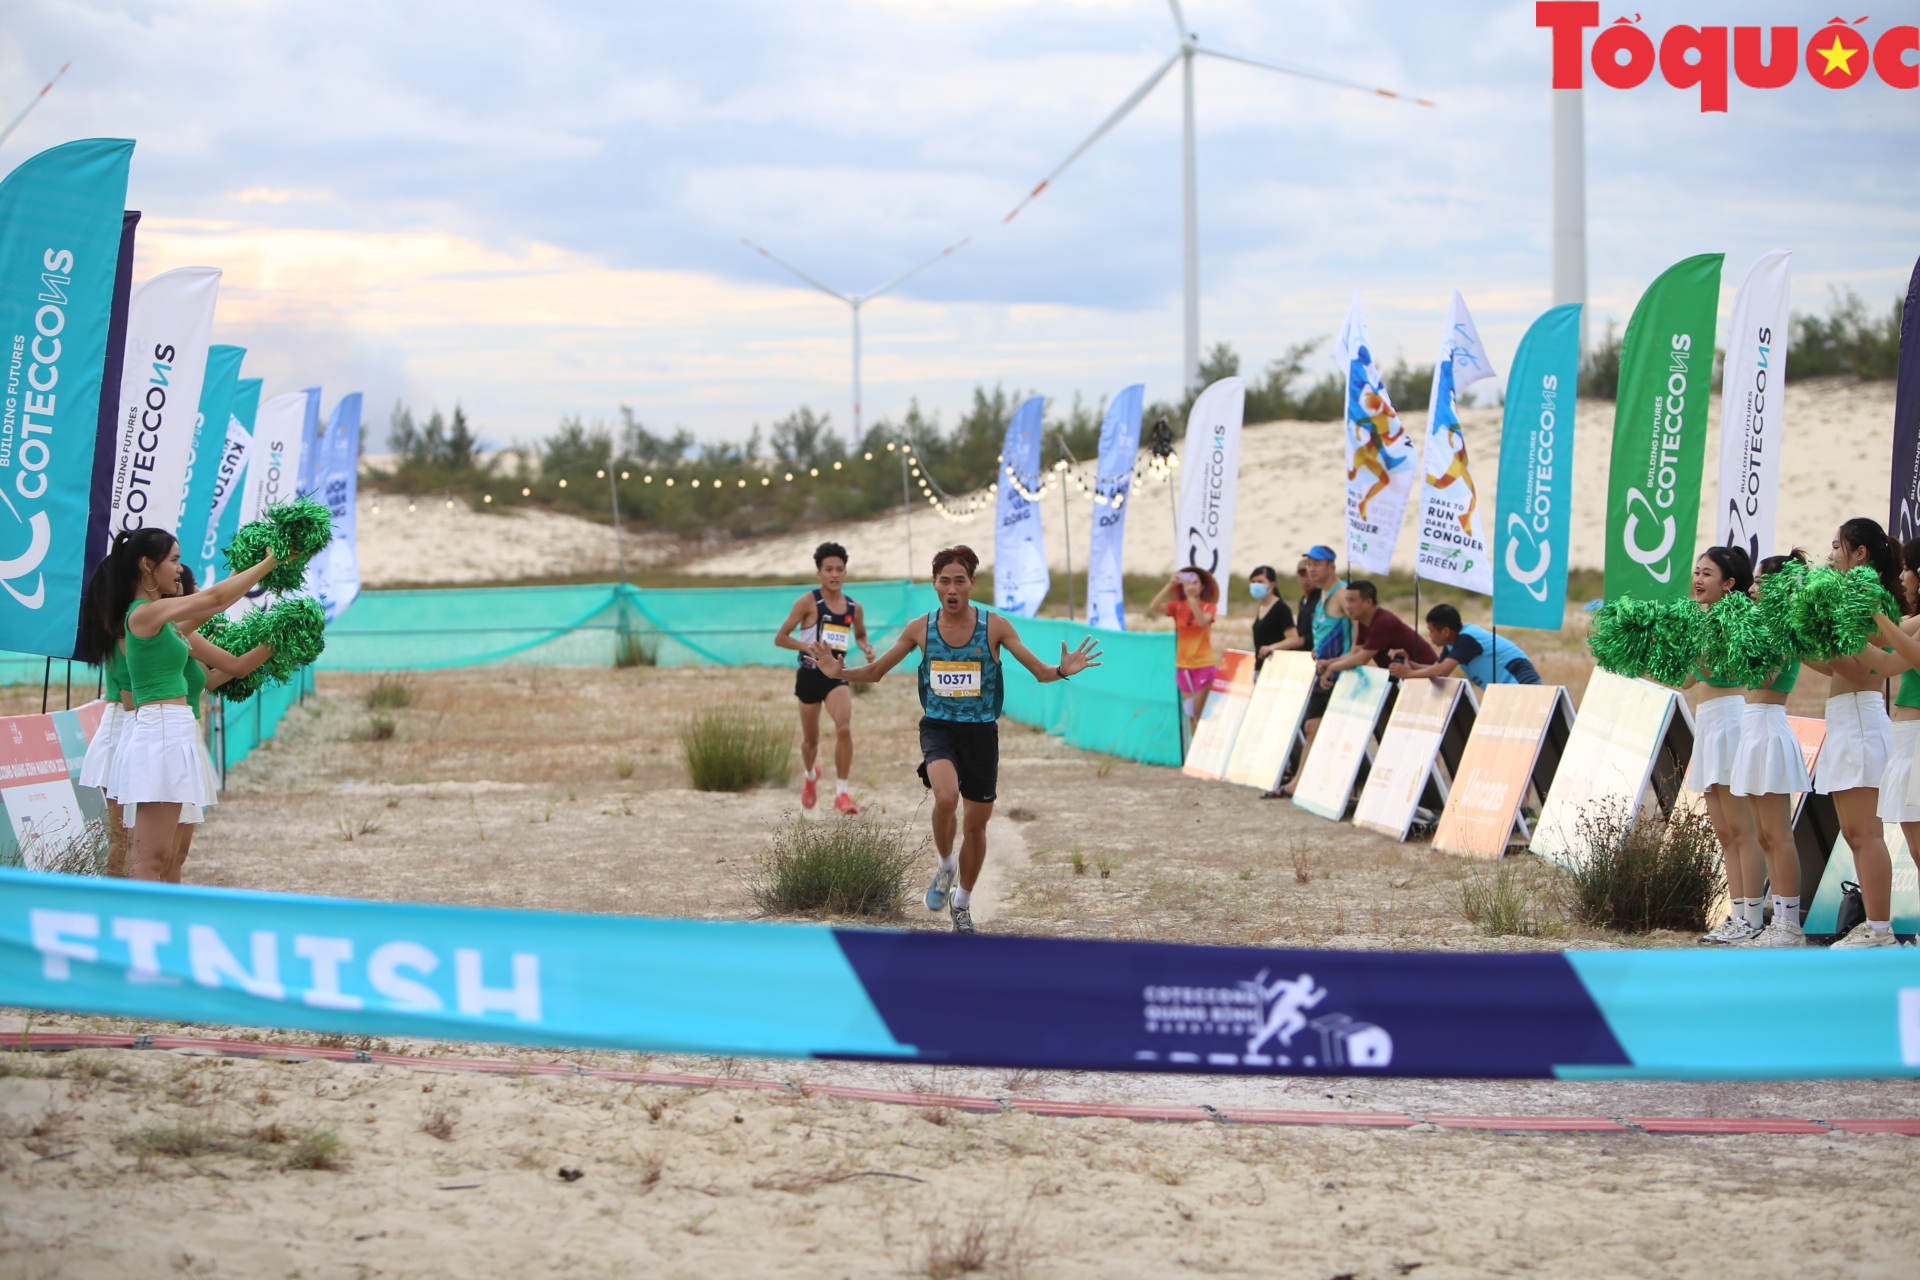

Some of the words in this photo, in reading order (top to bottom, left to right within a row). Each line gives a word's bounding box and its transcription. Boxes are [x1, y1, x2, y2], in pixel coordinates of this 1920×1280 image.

[8, 335, 25, 395] FUTURES
[16, 247, 74, 499] COTECCONS
[0, 398, 17, 467] BUILDING
[122, 343, 176, 532] COTECCONS
[1652, 396, 1663, 439] FUTURES
[1655, 333, 1692, 508] COTECCONS
[1746, 327, 1772, 517] COTECCONS
[112, 455, 129, 510] BUILDING
[123, 406, 138, 454] FUTURES
[1528, 430, 1537, 470] FUTURES
[1532, 374, 1558, 533] COTECCONS
[1647, 439, 1659, 488] BUILDING
[1740, 440, 1749, 494] BUILDING
[1207, 425, 1226, 538] COTECCONS
[1430, 497, 1451, 508] DARE
[1454, 503, 1464, 511] TO
[1525, 471, 1534, 514] BUILDING
[1423, 527, 1484, 551] CONQUER
[1425, 518, 1447, 529] DARE
[1450, 524, 1460, 532] TO
[1427, 506, 1454, 521] RUN
[1419, 553, 1458, 571] GREEN
[937, 674, 972, 685] 10371
[30, 908, 544, 1022] FINISH
